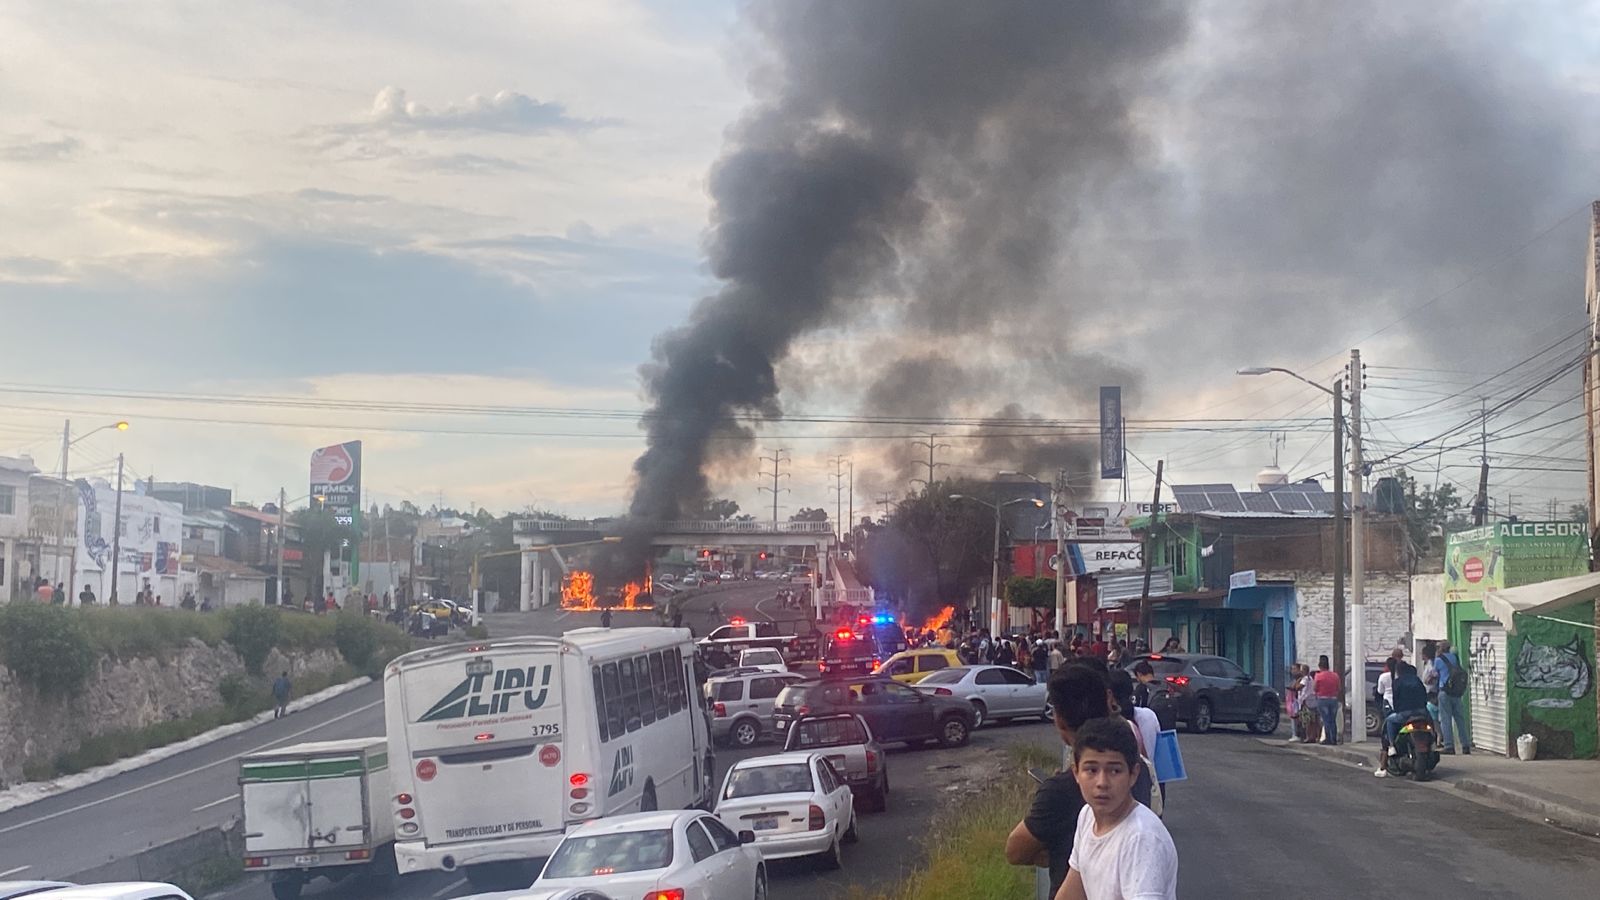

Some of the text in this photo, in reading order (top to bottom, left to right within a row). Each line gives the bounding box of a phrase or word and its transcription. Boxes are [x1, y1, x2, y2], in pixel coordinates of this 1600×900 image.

[1500, 523, 1588, 537] ACCESORI
[531, 723, 559, 736] 3795
[446, 827, 478, 838] TRANSPORTE
[479, 824, 502, 835] ESCOLAR
[507, 823, 514, 832] DE
[515, 820, 543, 831] PERSONAL
